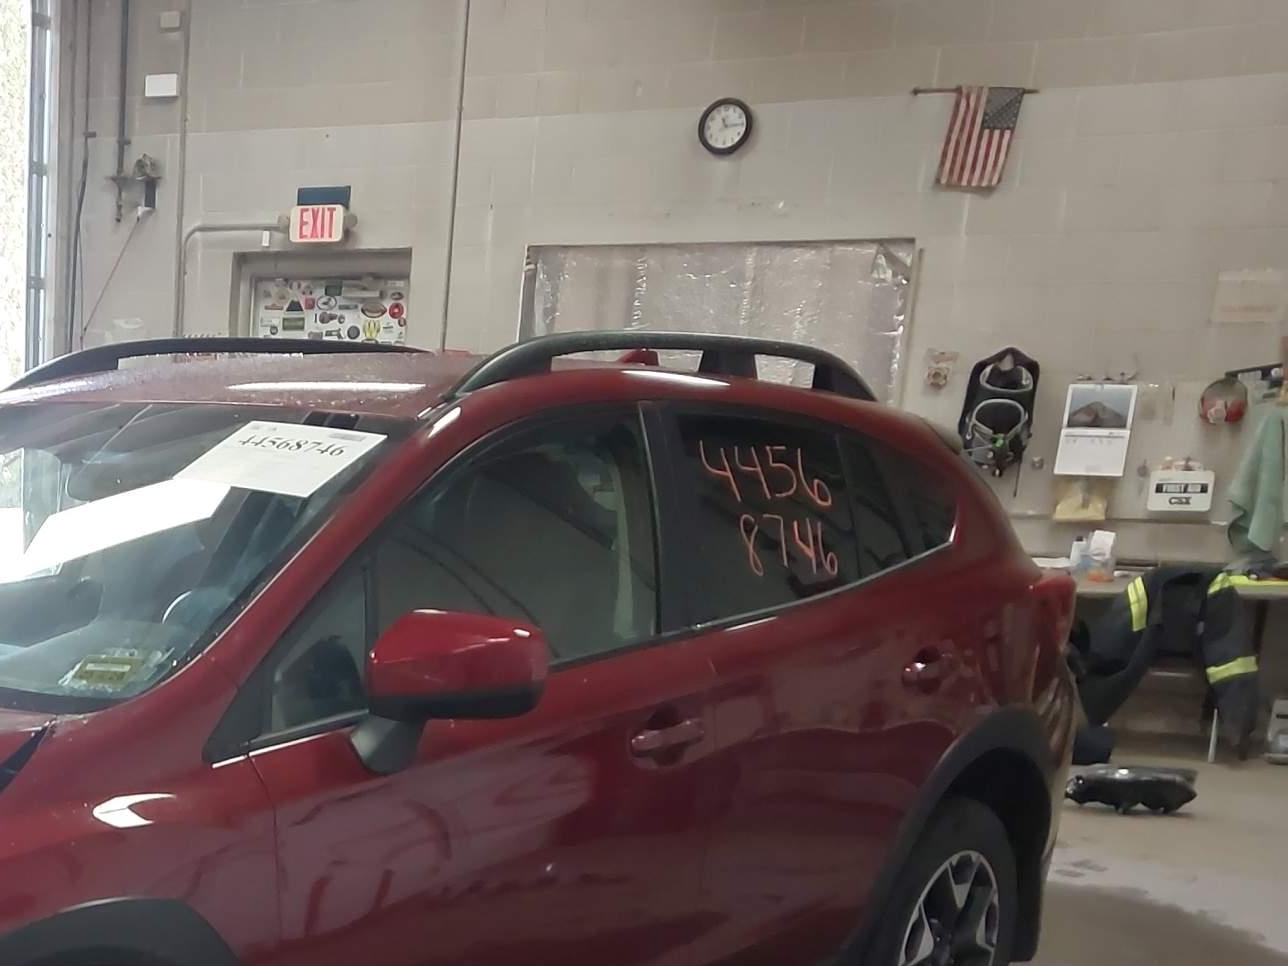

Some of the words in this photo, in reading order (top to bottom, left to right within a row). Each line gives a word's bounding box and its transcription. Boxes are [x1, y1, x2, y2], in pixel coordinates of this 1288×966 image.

[299, 207, 336, 239] EXIT
[239, 434, 346, 456] 44568746
[699, 439, 833, 507] 4456
[740, 514, 839, 577] 8746
